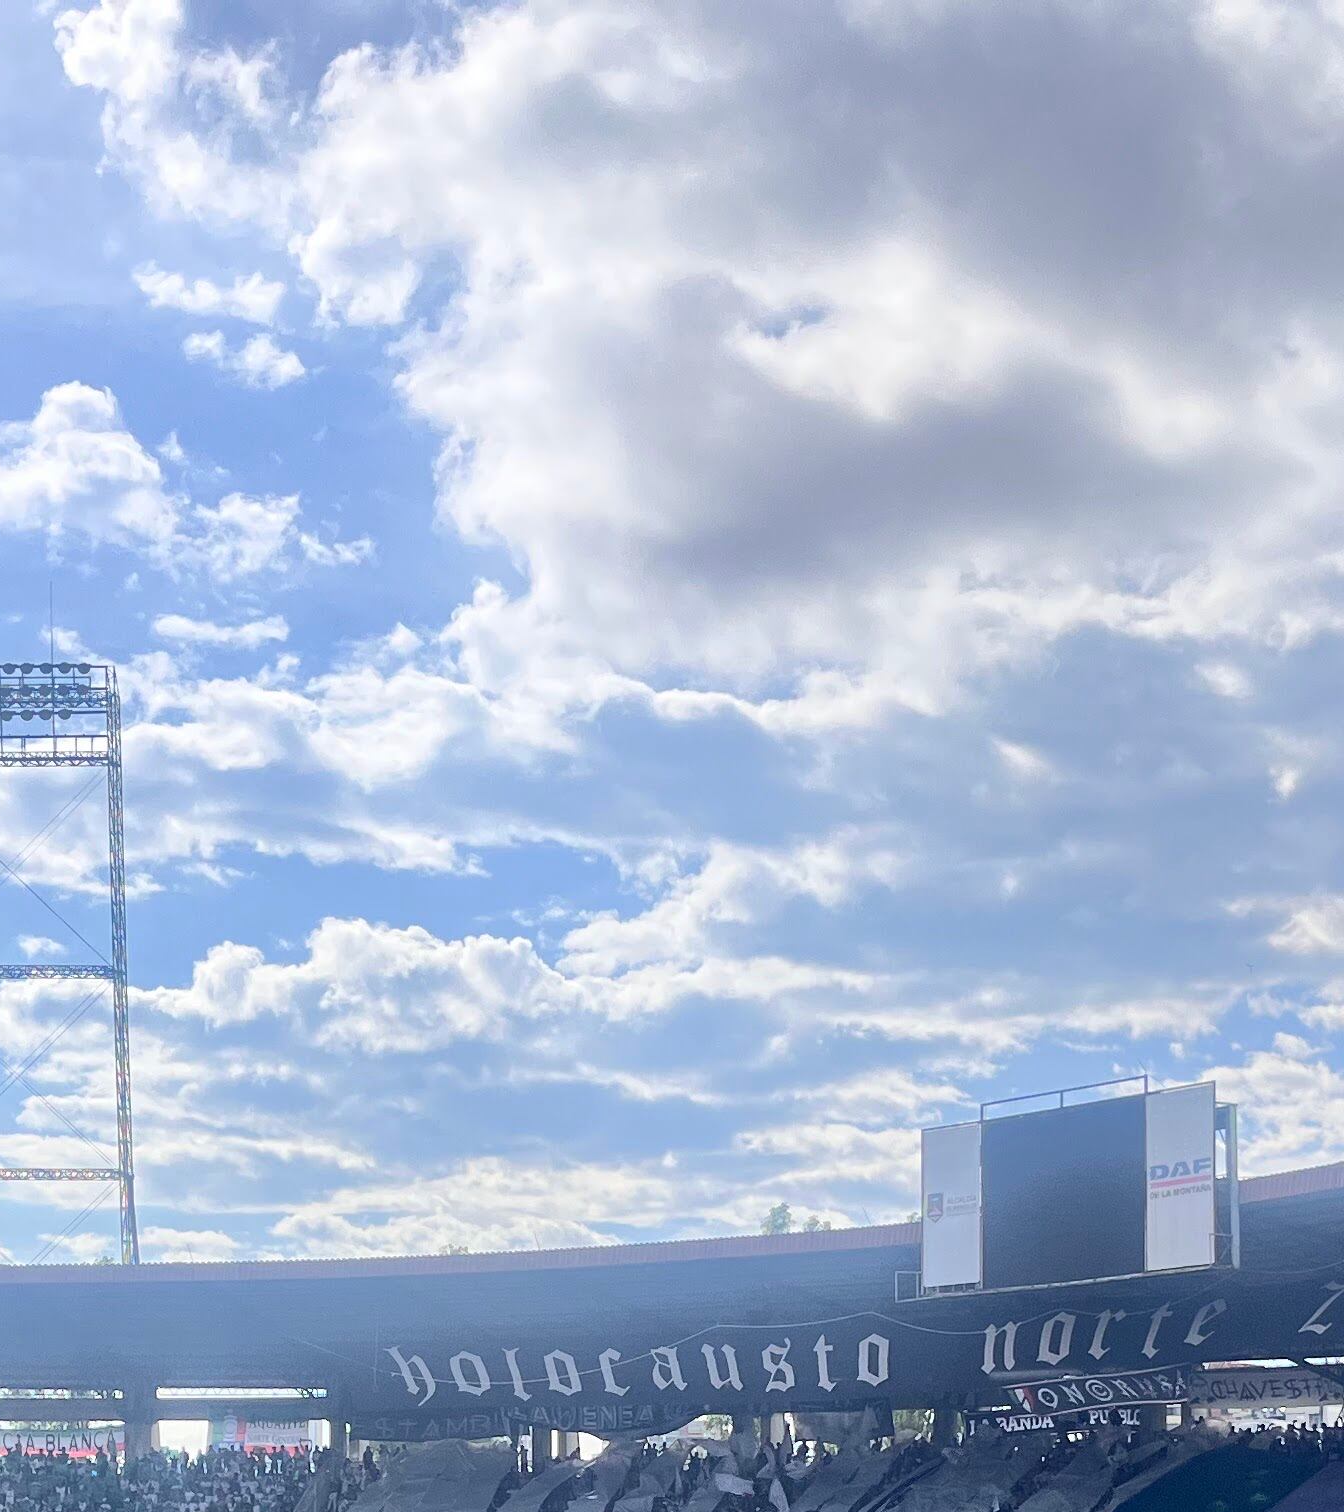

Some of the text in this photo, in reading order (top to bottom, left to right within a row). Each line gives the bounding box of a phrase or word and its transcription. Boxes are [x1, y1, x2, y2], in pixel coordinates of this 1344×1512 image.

[1149, 1157, 1212, 1180] DAF
[981, 1299, 1229, 1375] norte
[45, 1429, 117, 1452] BLANCA
